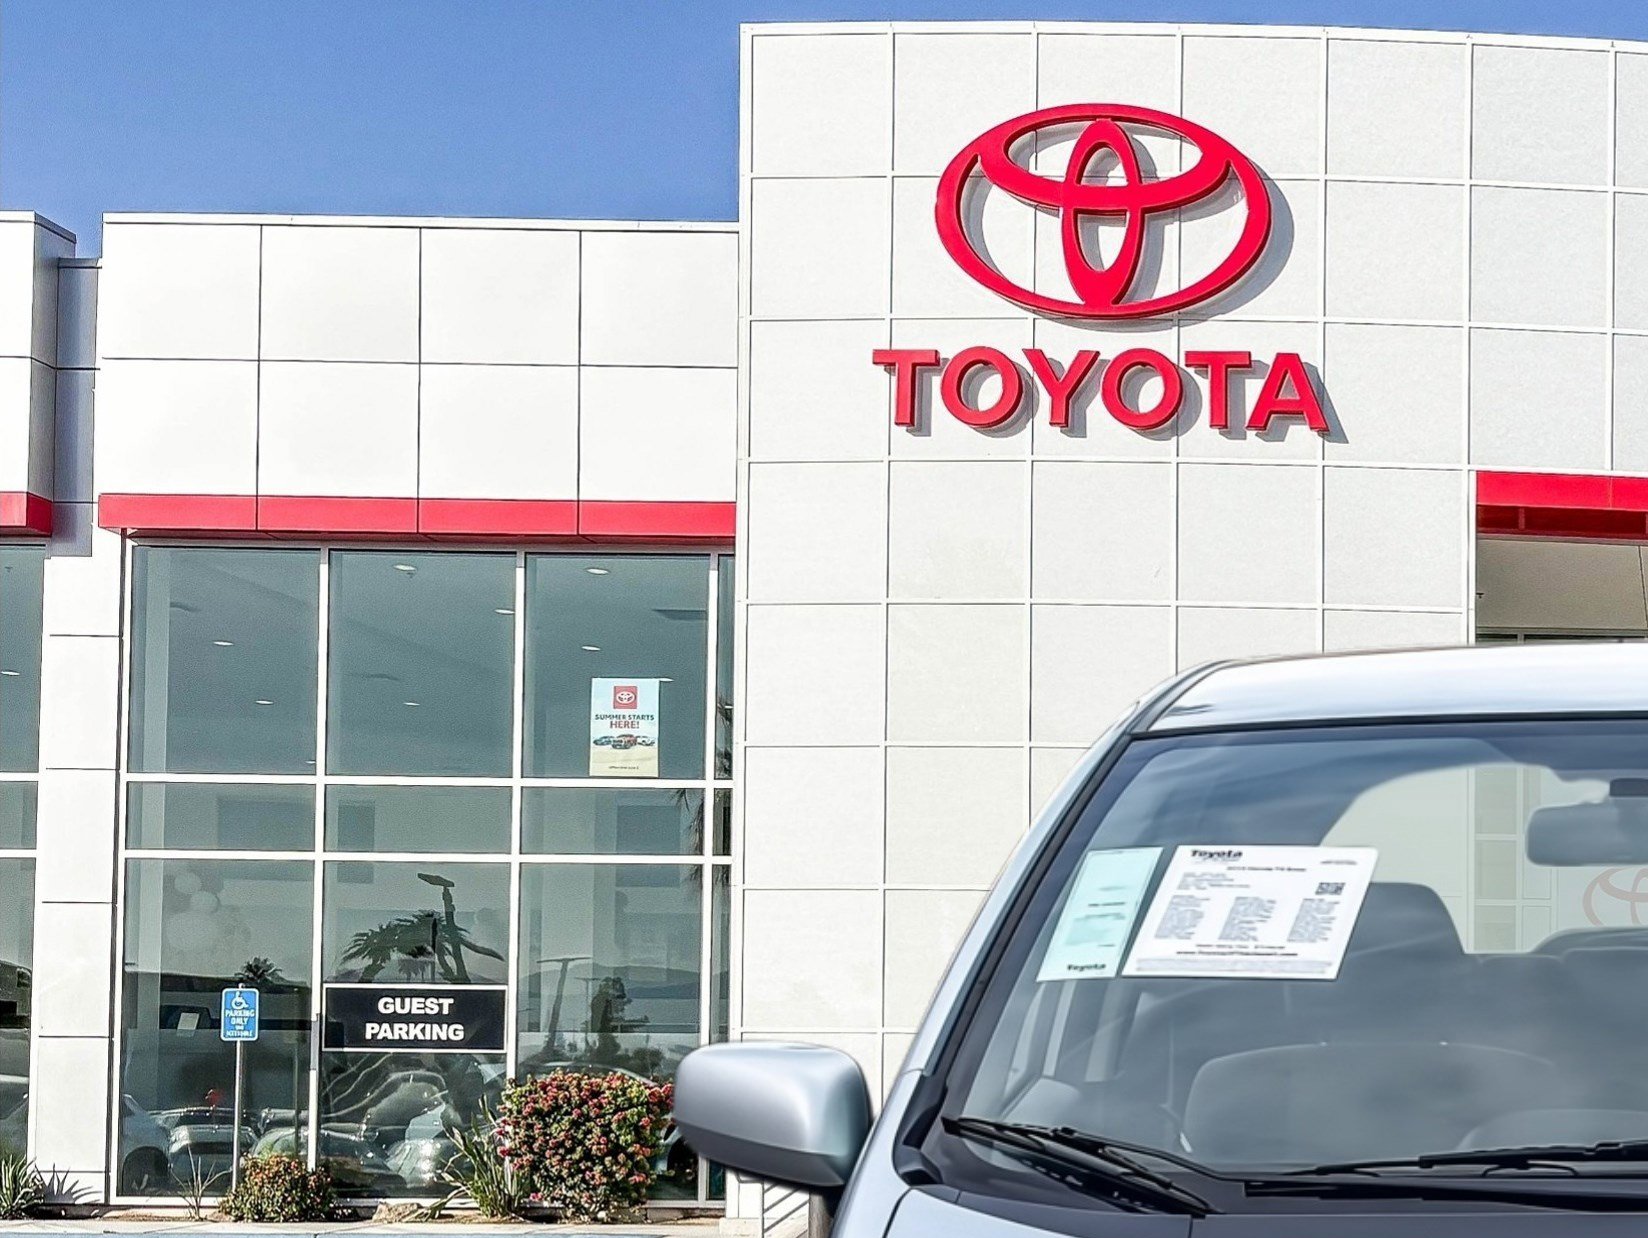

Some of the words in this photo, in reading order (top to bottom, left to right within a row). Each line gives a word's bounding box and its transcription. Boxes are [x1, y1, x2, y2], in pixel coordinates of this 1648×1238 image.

[872, 345, 1330, 432] TOYOTA
[609, 720, 640, 729] HERE!
[1190, 849, 1243, 859] Toyota
[377, 996, 454, 1015] GUEST
[225, 1009, 255, 1017] PARKING
[230, 1017, 249, 1025] ONLY
[364, 1022, 465, 1042] PARKING
